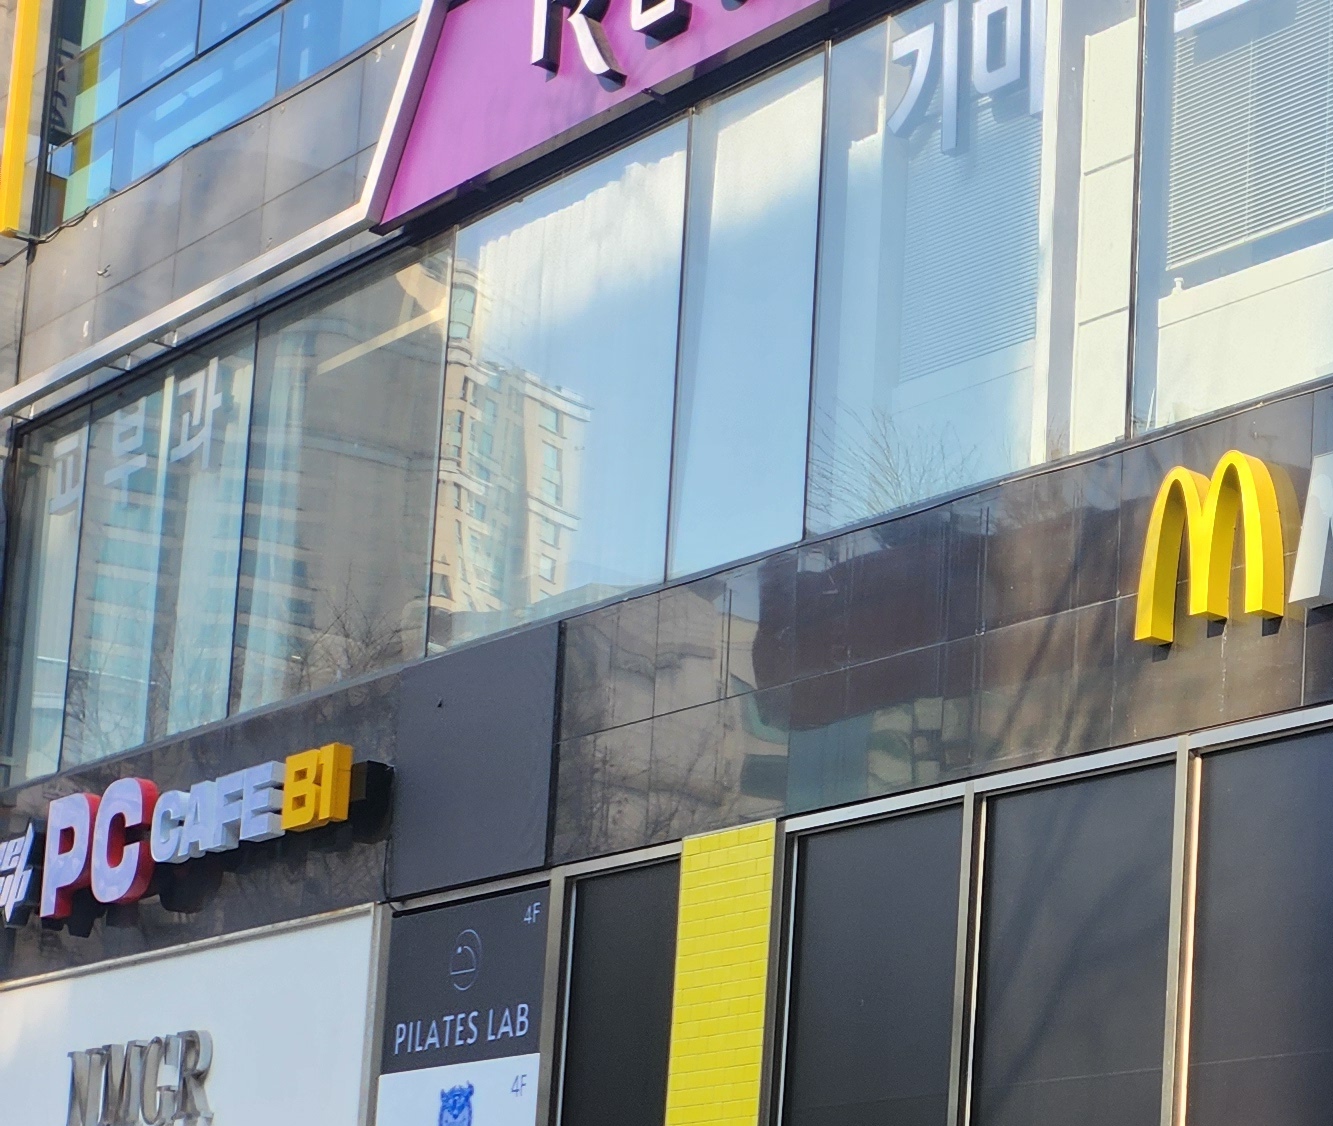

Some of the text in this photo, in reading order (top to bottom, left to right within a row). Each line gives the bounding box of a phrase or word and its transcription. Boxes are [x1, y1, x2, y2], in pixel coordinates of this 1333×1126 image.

[39, 741, 354, 918] PC CAFE B1
[523, 902, 541, 924] 4F
[393, 1003, 530, 1056] PILATES LAB
[511, 1074, 528, 1097] 4F
